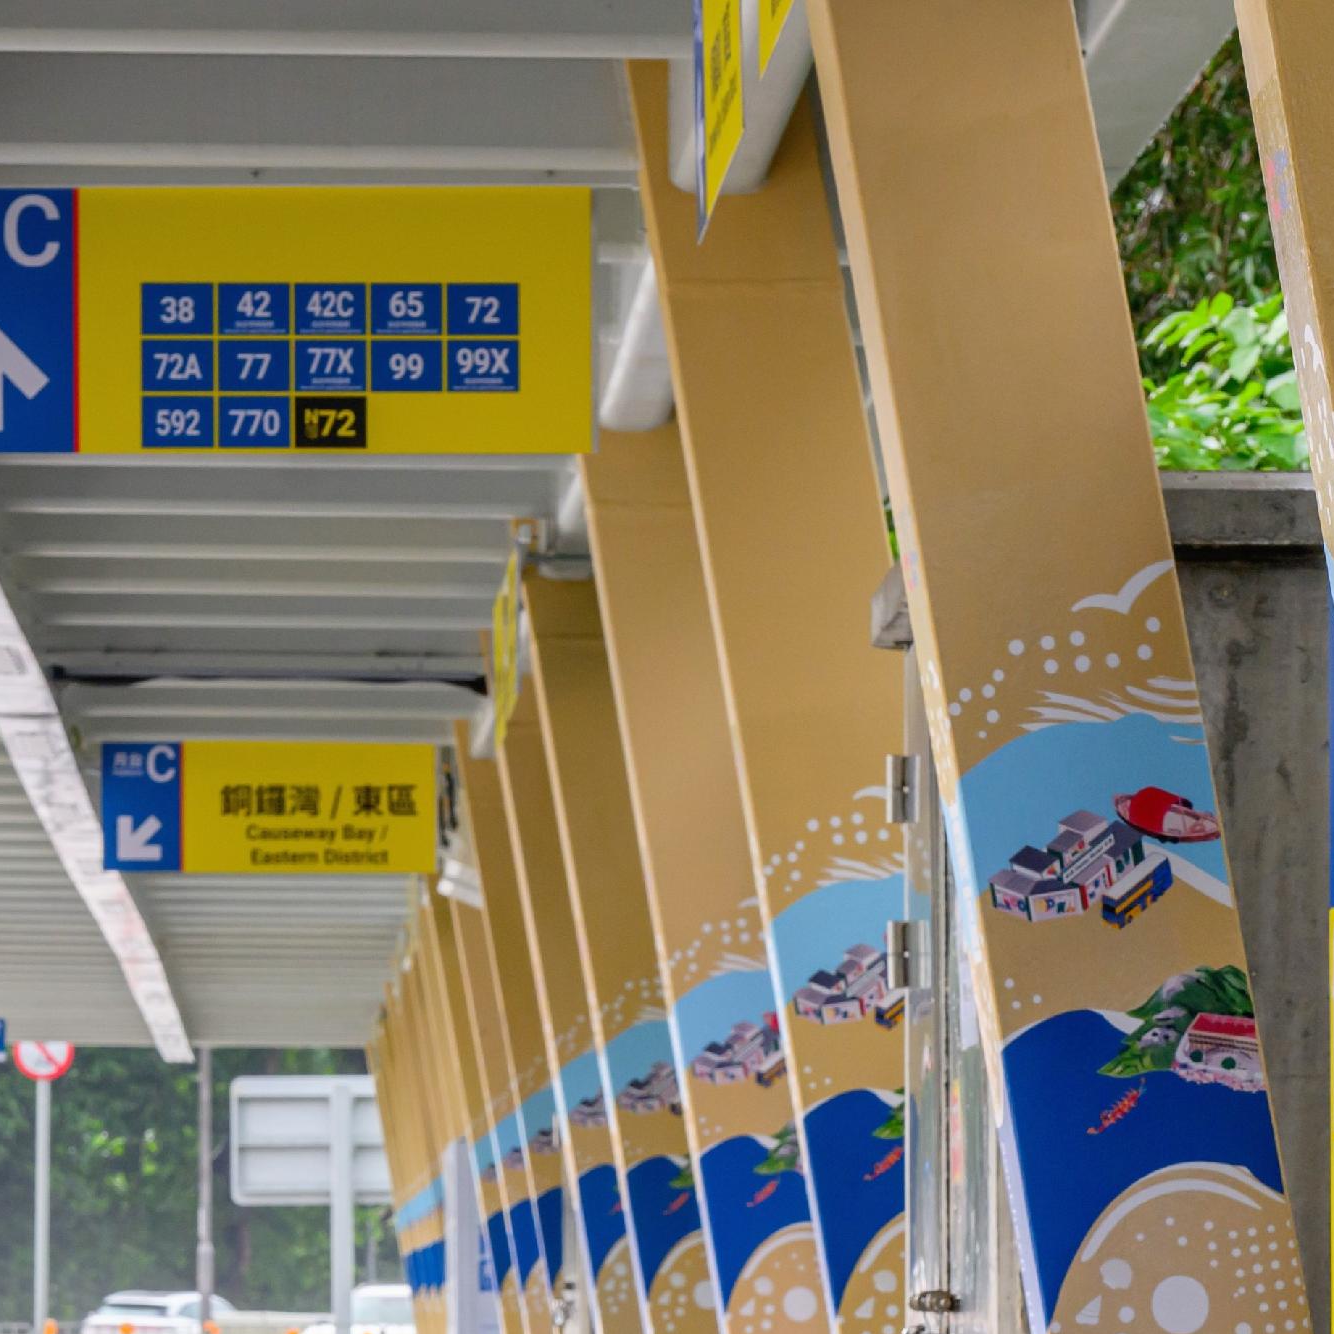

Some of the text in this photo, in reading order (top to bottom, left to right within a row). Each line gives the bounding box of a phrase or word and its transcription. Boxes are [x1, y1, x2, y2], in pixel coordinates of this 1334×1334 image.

[3, 194, 61, 268] C
[159, 291, 501, 324] 38 42 42C 65 72
[153, 347, 510, 380] 72A 77 77X 99 99X
[155, 409, 201, 437] 592
[228, 409, 281, 437] 770
[146, 745, 176, 783] C
[220, 784, 320, 817] 銅鑼灣
[352, 784, 418, 816] 東區
[245, 824, 336, 844] Causeway
[342, 824, 376, 844] Bay
[251, 848, 389, 865] Eastern District
